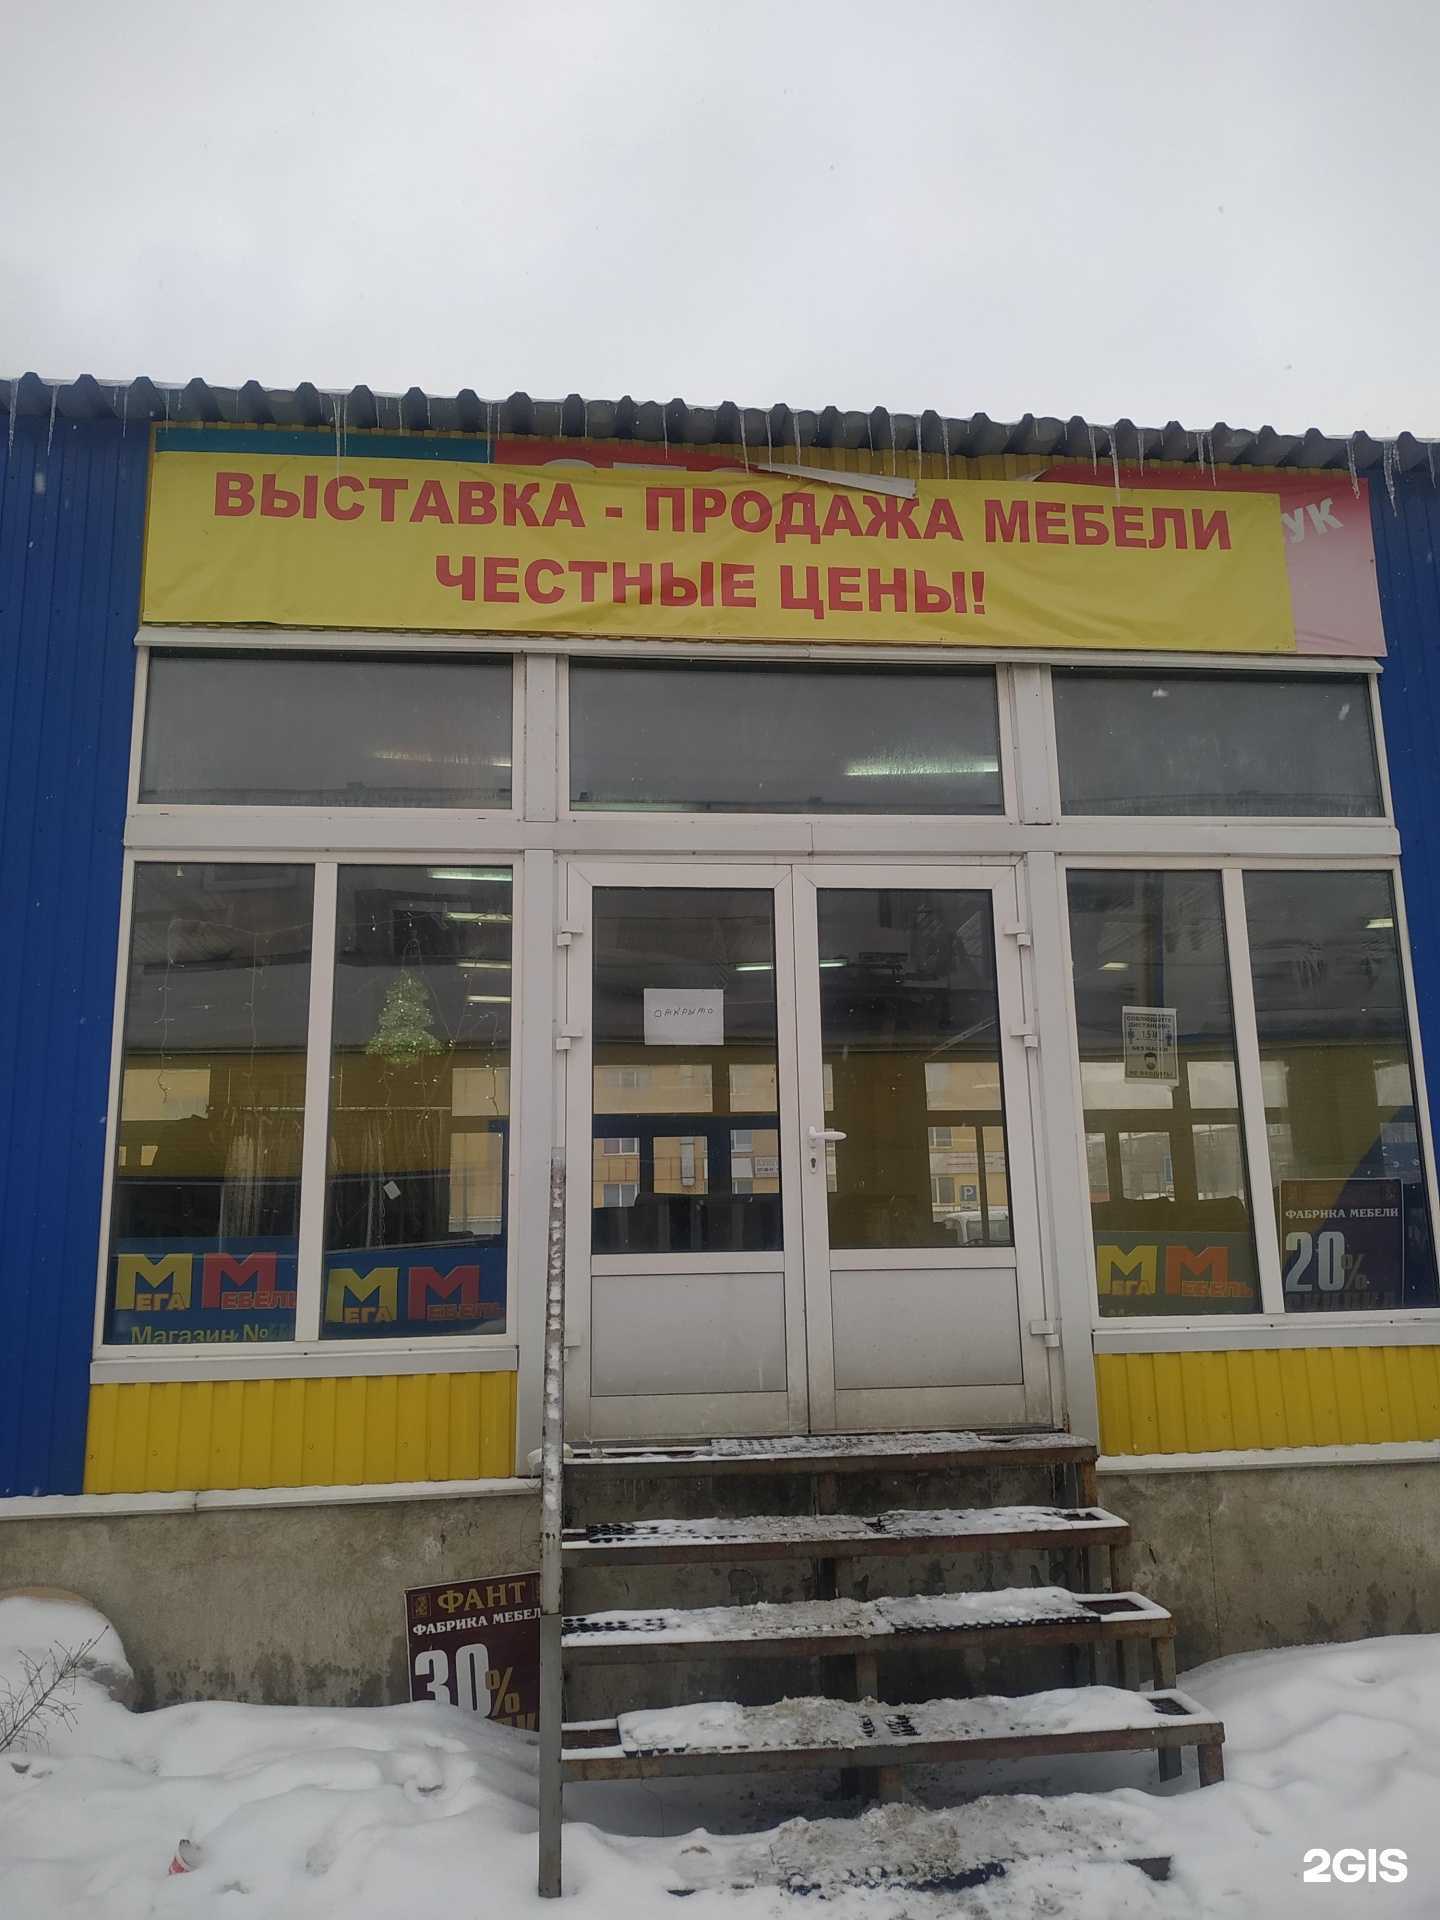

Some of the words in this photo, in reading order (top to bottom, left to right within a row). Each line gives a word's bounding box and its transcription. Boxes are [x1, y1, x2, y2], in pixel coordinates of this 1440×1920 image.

[213, 472, 586, 529] ВЫСТАВКА
[644, 487, 965, 545] ПРОДАЖА
[983, 499, 1232, 550] МЕБЕЛИ
[434, 554, 757, 609] ЧЕСТНЫЕ
[778, 564, 986, 620] ЦЕНЫ!
[1285, 1208, 1347, 1219] ФАБРИКА
[1349, 1207, 1400, 1218] МЕБЕЛИ
[413, 1615, 489, 1636] ФАБРИКА
[492, 1607, 541, 1625] МЕБЕЛ
[437, 1581, 527, 1614] ФАНТ
[414, 1643, 520, 1719] 30%
